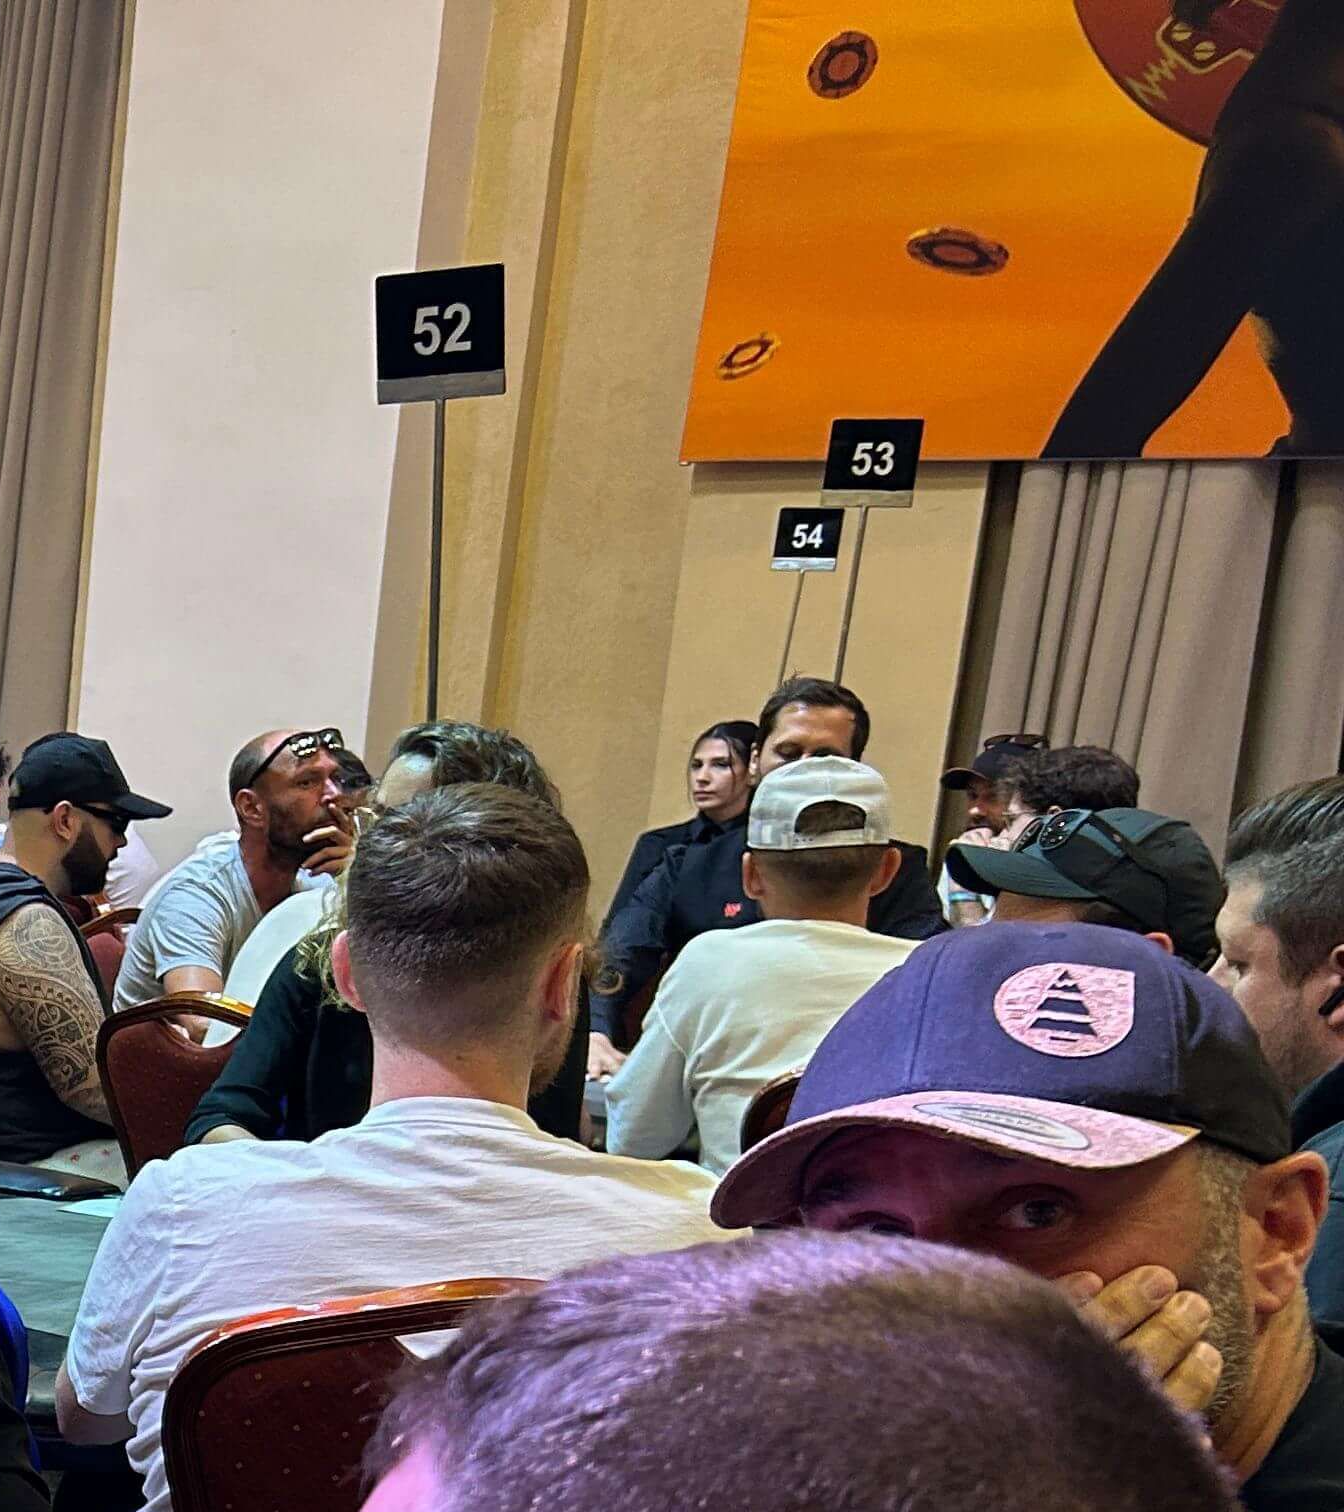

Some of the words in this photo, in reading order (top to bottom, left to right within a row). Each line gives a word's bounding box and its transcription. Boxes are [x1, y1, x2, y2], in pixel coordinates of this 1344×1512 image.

[412, 301, 472, 356] 52
[851, 440, 895, 476] 53
[792, 523, 823, 549] 54
